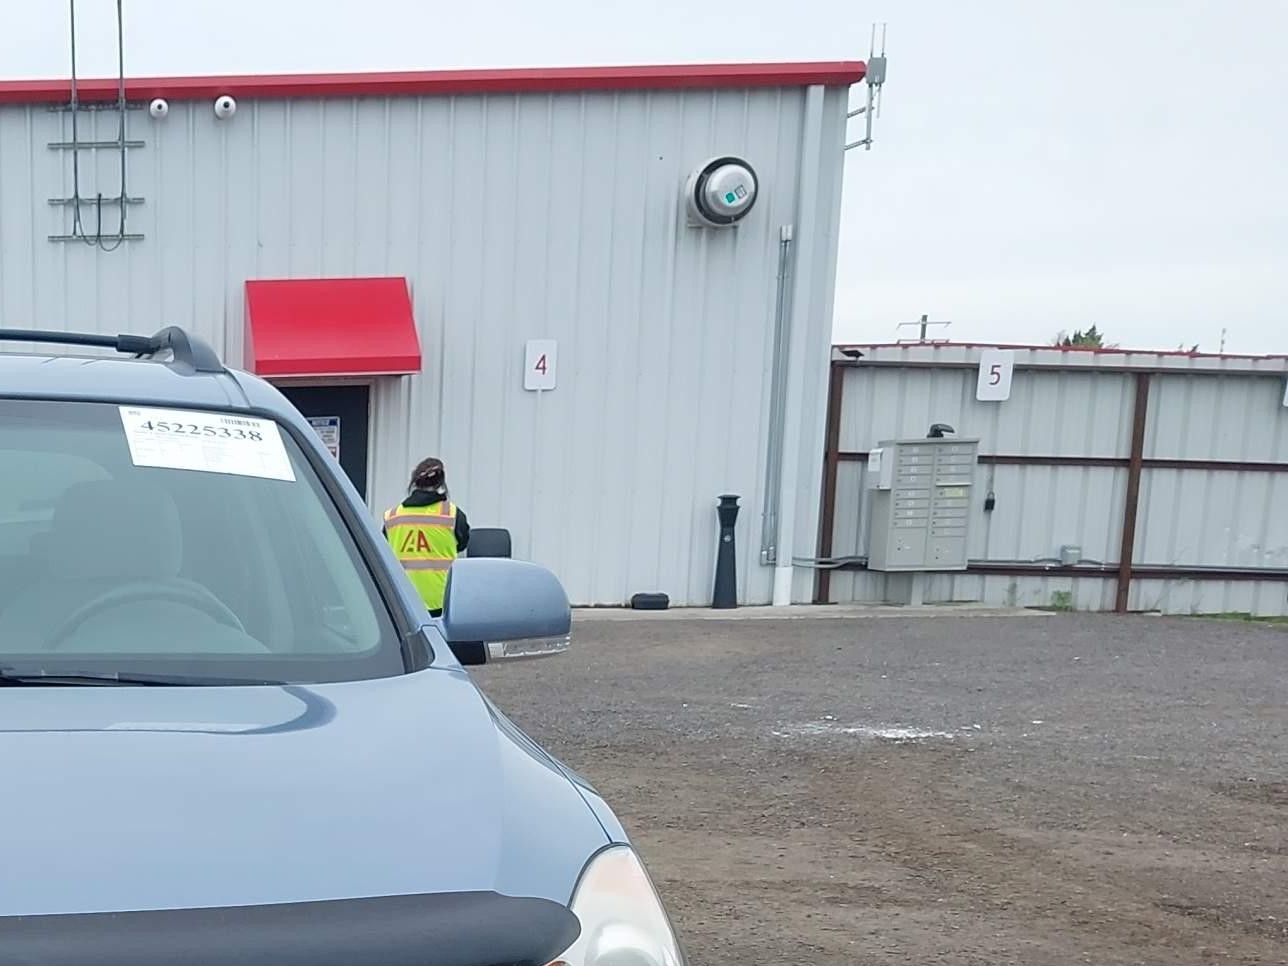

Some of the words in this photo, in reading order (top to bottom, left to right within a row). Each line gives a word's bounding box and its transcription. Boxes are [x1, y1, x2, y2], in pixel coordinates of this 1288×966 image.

[534, 354, 547, 376] 4
[988, 364, 1002, 386] 5
[140, 419, 264, 442] 45225338
